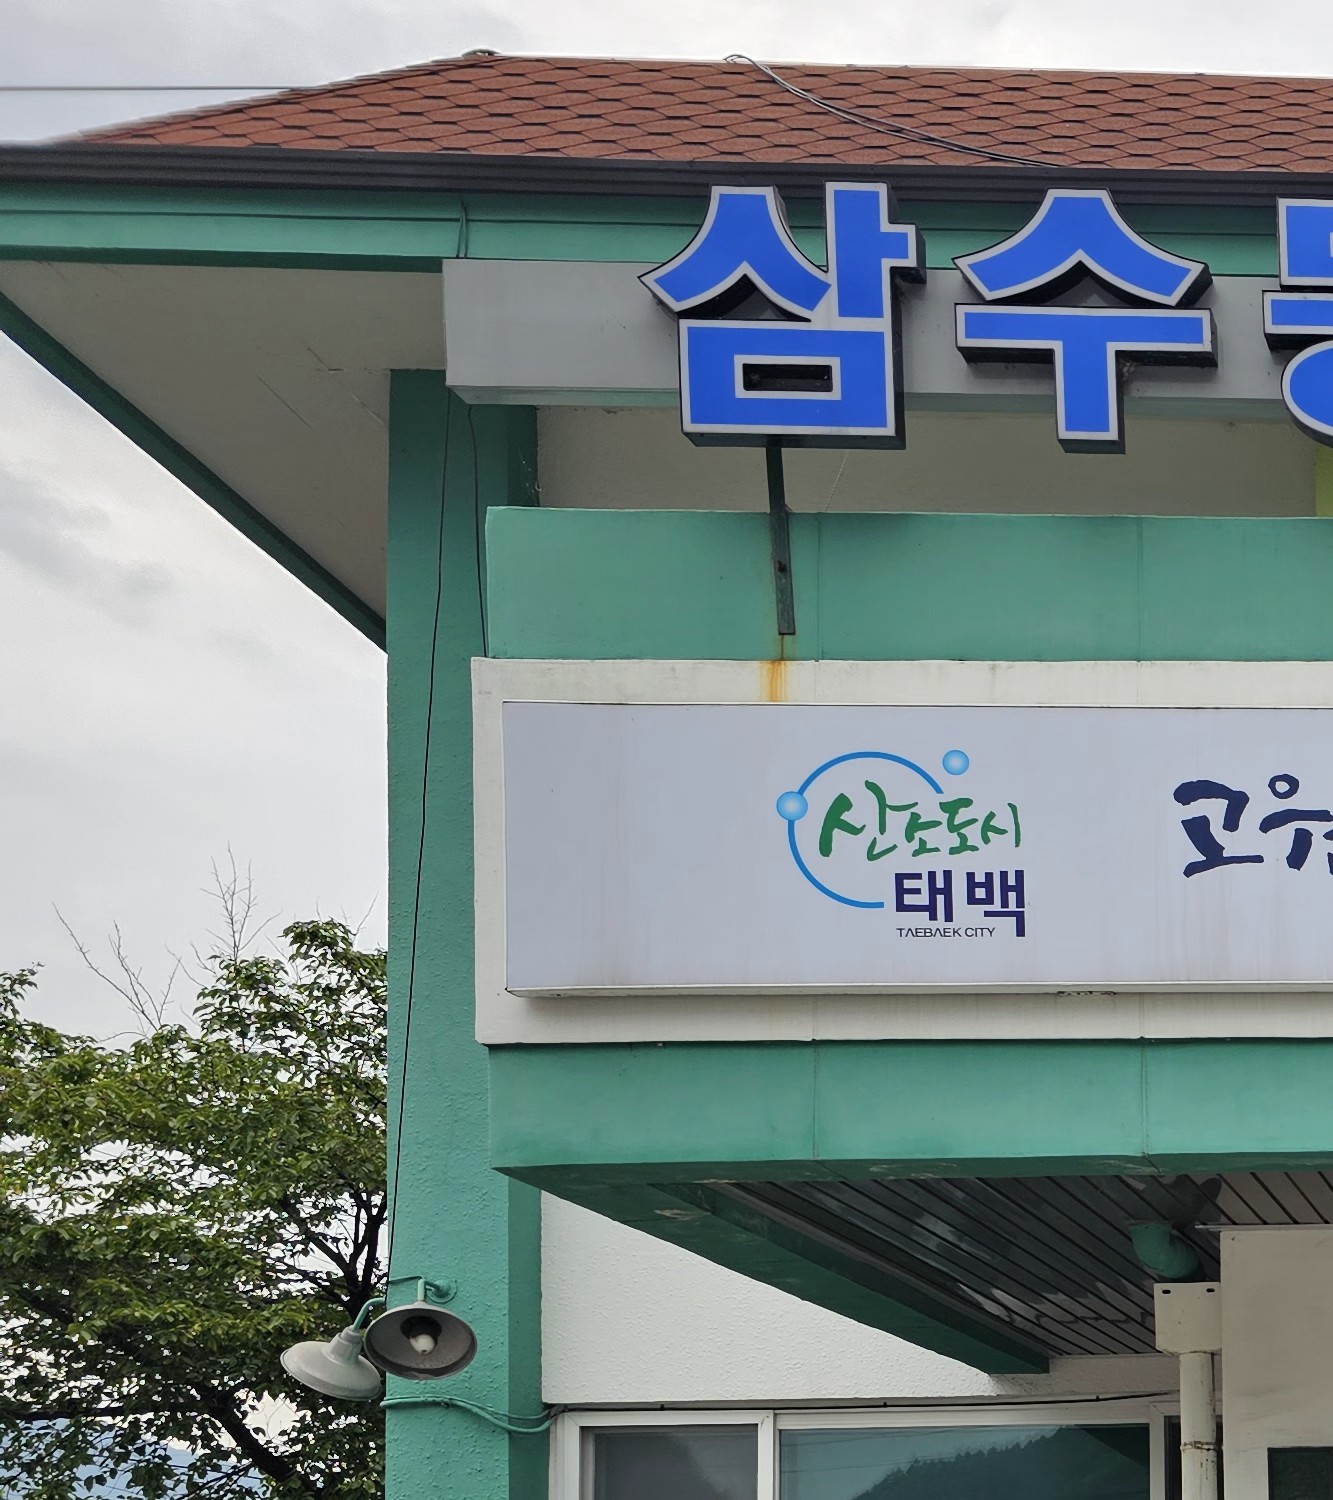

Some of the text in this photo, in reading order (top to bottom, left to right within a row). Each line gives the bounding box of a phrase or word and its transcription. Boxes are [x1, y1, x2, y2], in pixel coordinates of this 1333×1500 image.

[818, 779, 1021, 862] 산소도시
[895, 869, 1026, 938] 태백
[896, 927, 995, 938] TAEBAEK CITY
